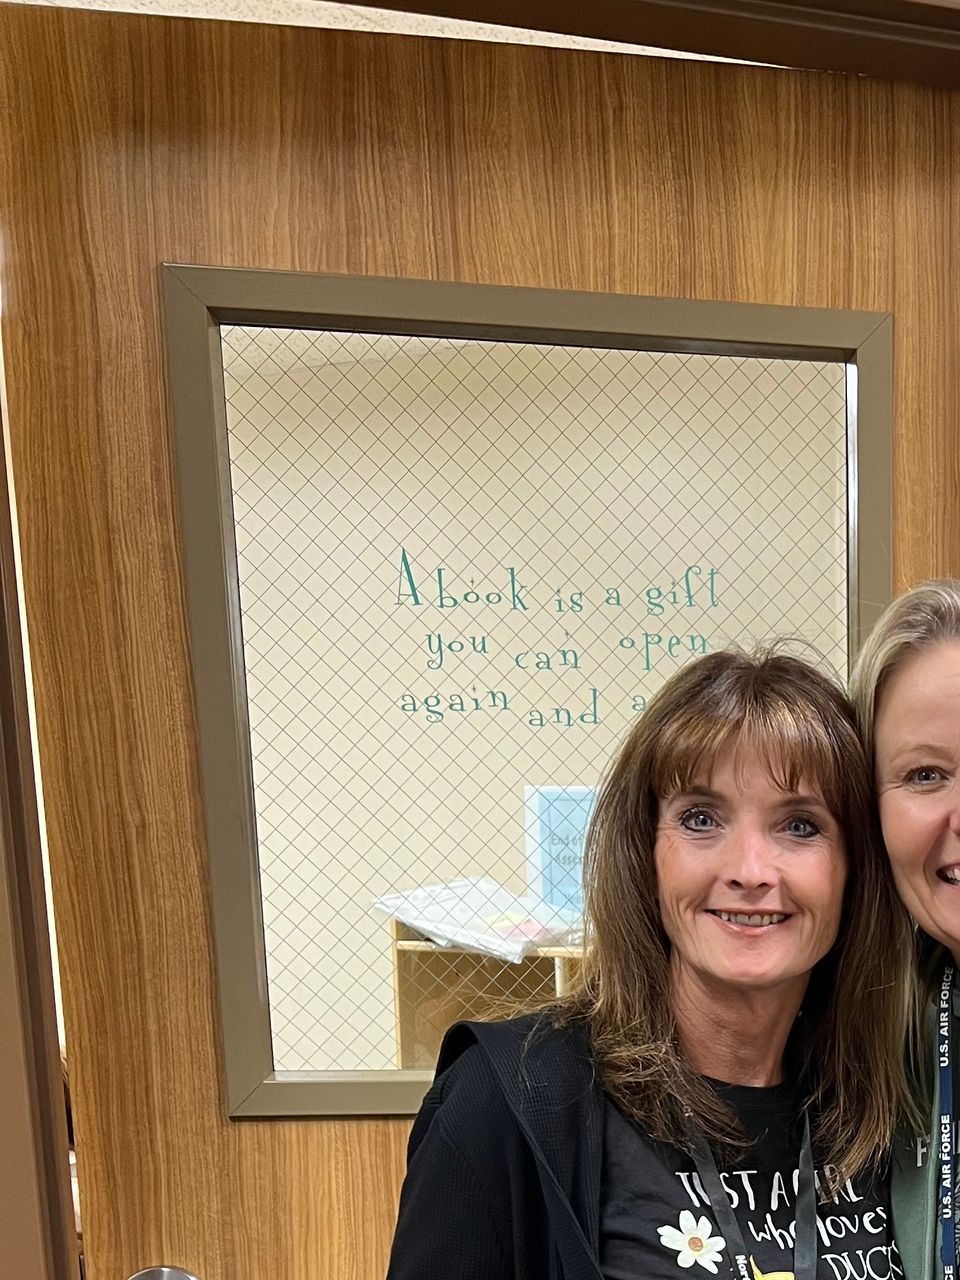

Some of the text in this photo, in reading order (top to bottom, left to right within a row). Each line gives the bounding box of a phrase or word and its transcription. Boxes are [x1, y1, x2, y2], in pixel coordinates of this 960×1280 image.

[394, 546, 720, 616] A book is a gift
[425, 631, 709, 671] you can open
[400, 688, 511, 724] again
[528, 688, 600, 727] and
[940, 966, 954, 1067] U.S. AIR FORCE
[771, 1171, 790, 1211] A
[941, 1114, 952, 1219] U.S. AIR FORCE
